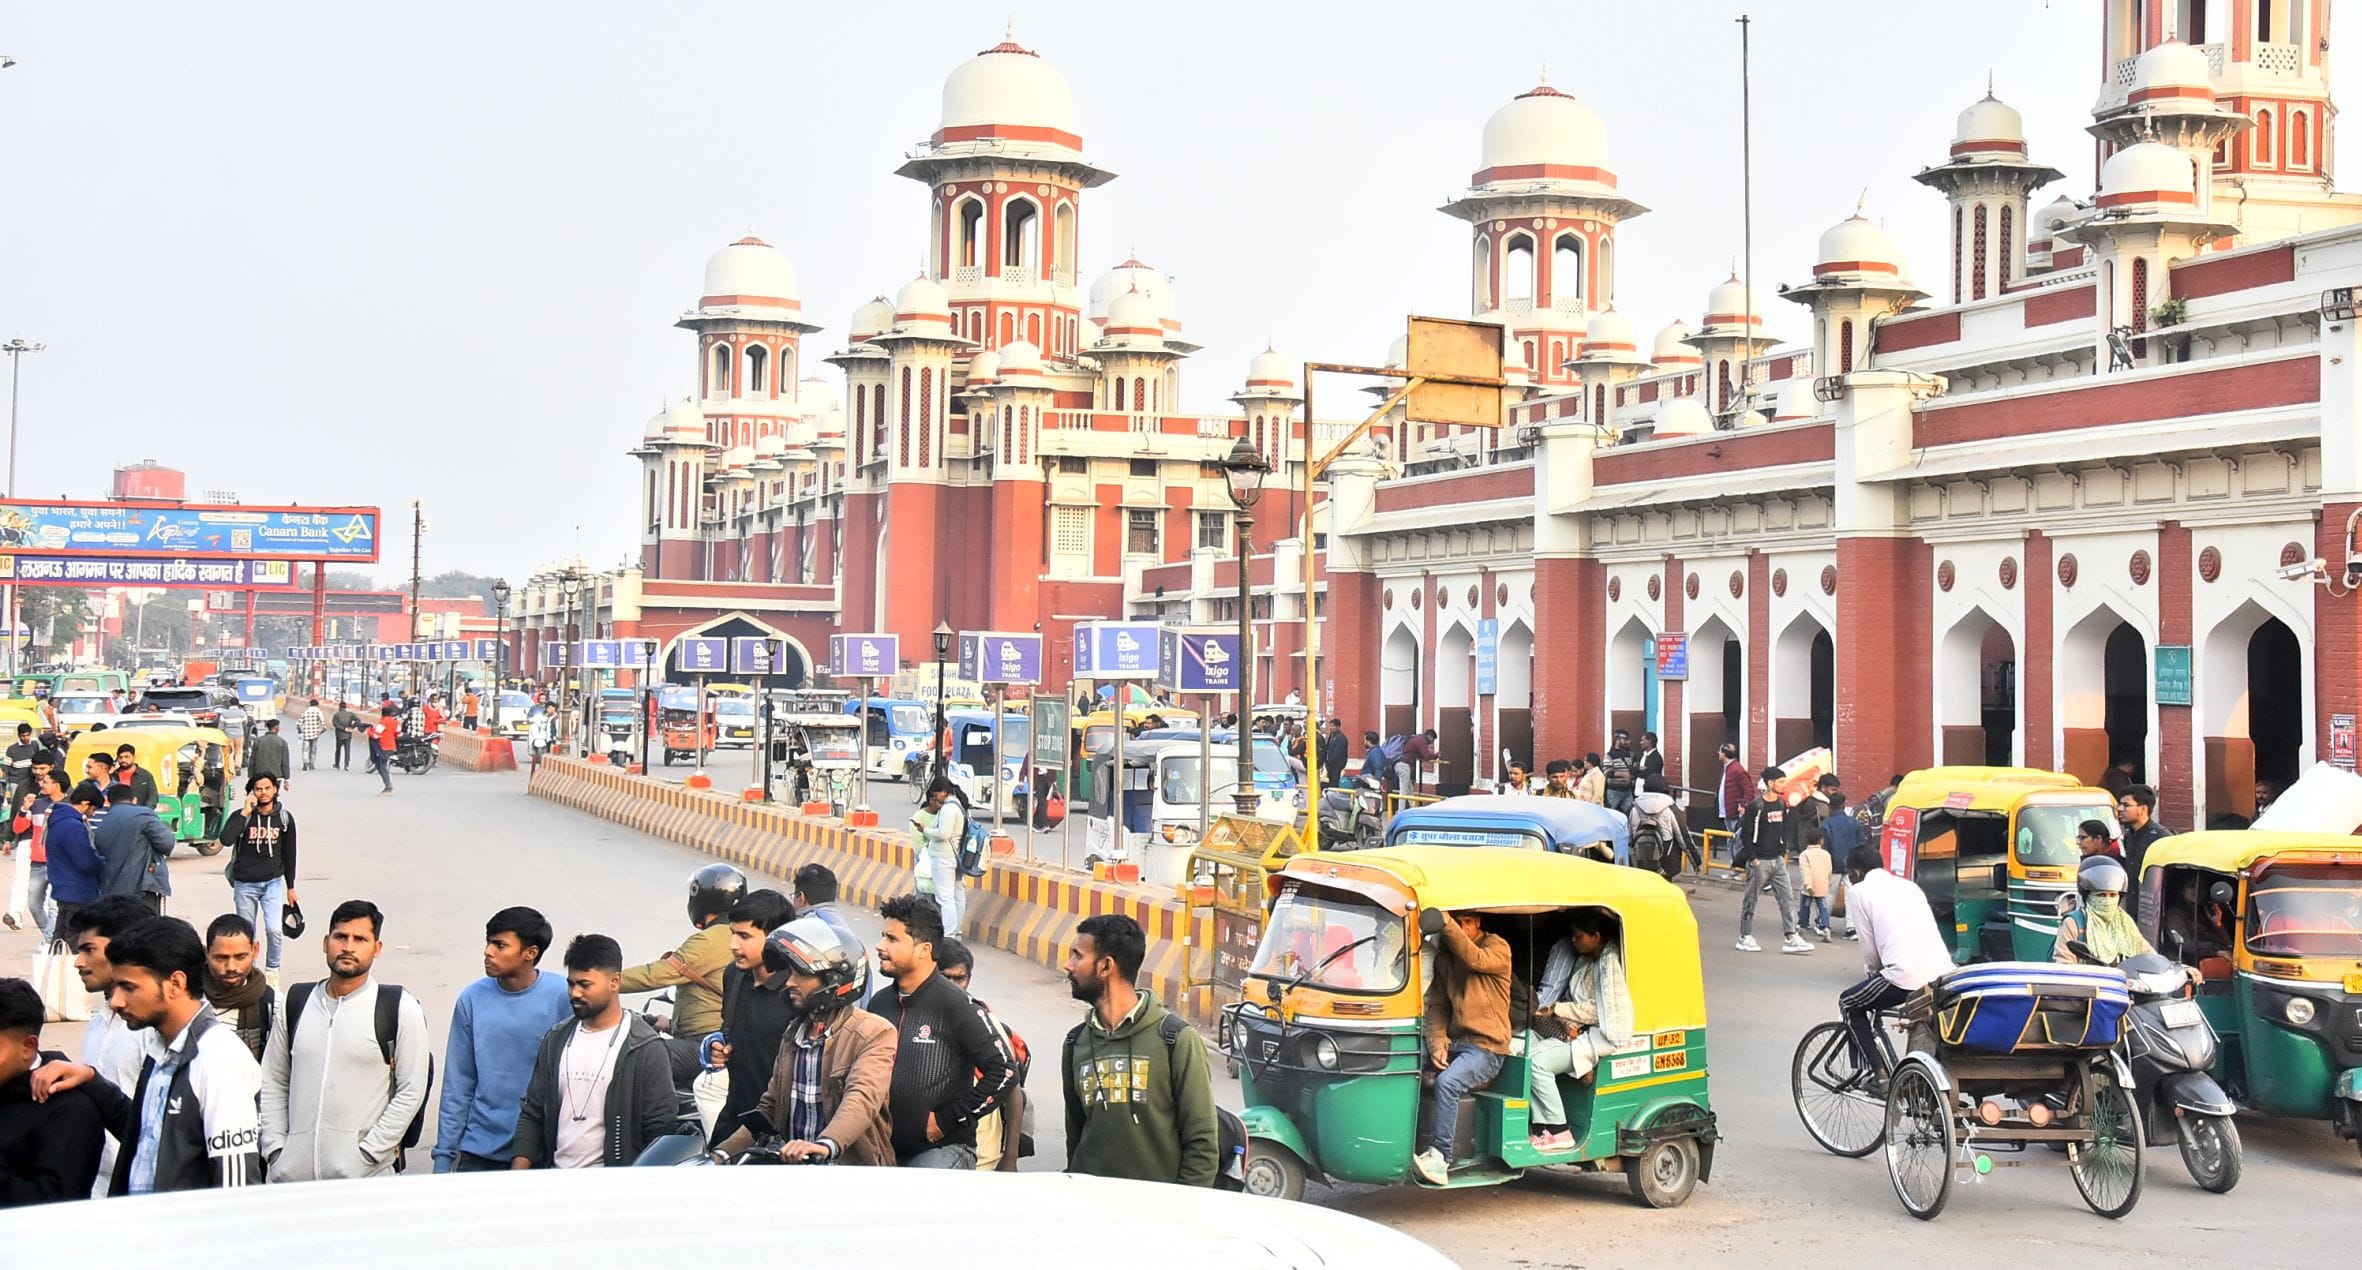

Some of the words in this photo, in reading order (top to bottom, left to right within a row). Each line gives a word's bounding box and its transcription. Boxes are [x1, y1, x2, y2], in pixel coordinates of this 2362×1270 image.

[31, 507, 48, 517] युवा
[51, 507, 77, 518] भारत,
[80, 507, 97, 518] युवा
[70, 519, 92, 530] हमारे
[258, 526, 298, 537] Canara
[300, 527, 329, 538] Bank
[20, 560, 64, 578] लखनऊ
[65, 560, 107, 580] आगमन
[109, 562, 125, 580] पर
[125, 562, 161, 581] आपका
[162, 559, 197, 582] हार्दिक
[198, 564, 234, 582] स्वागत
[234, 560, 244, 584] है
[269, 563, 286, 576] LIC
[1119, 652, 1139, 664] ixigo
[1002, 662, 1021, 673] ixigo
[1204, 664, 1229, 677] ixigo
[1037, 734, 1051, 751] STOP
[1082, 1060, 1143, 1077] FACT
